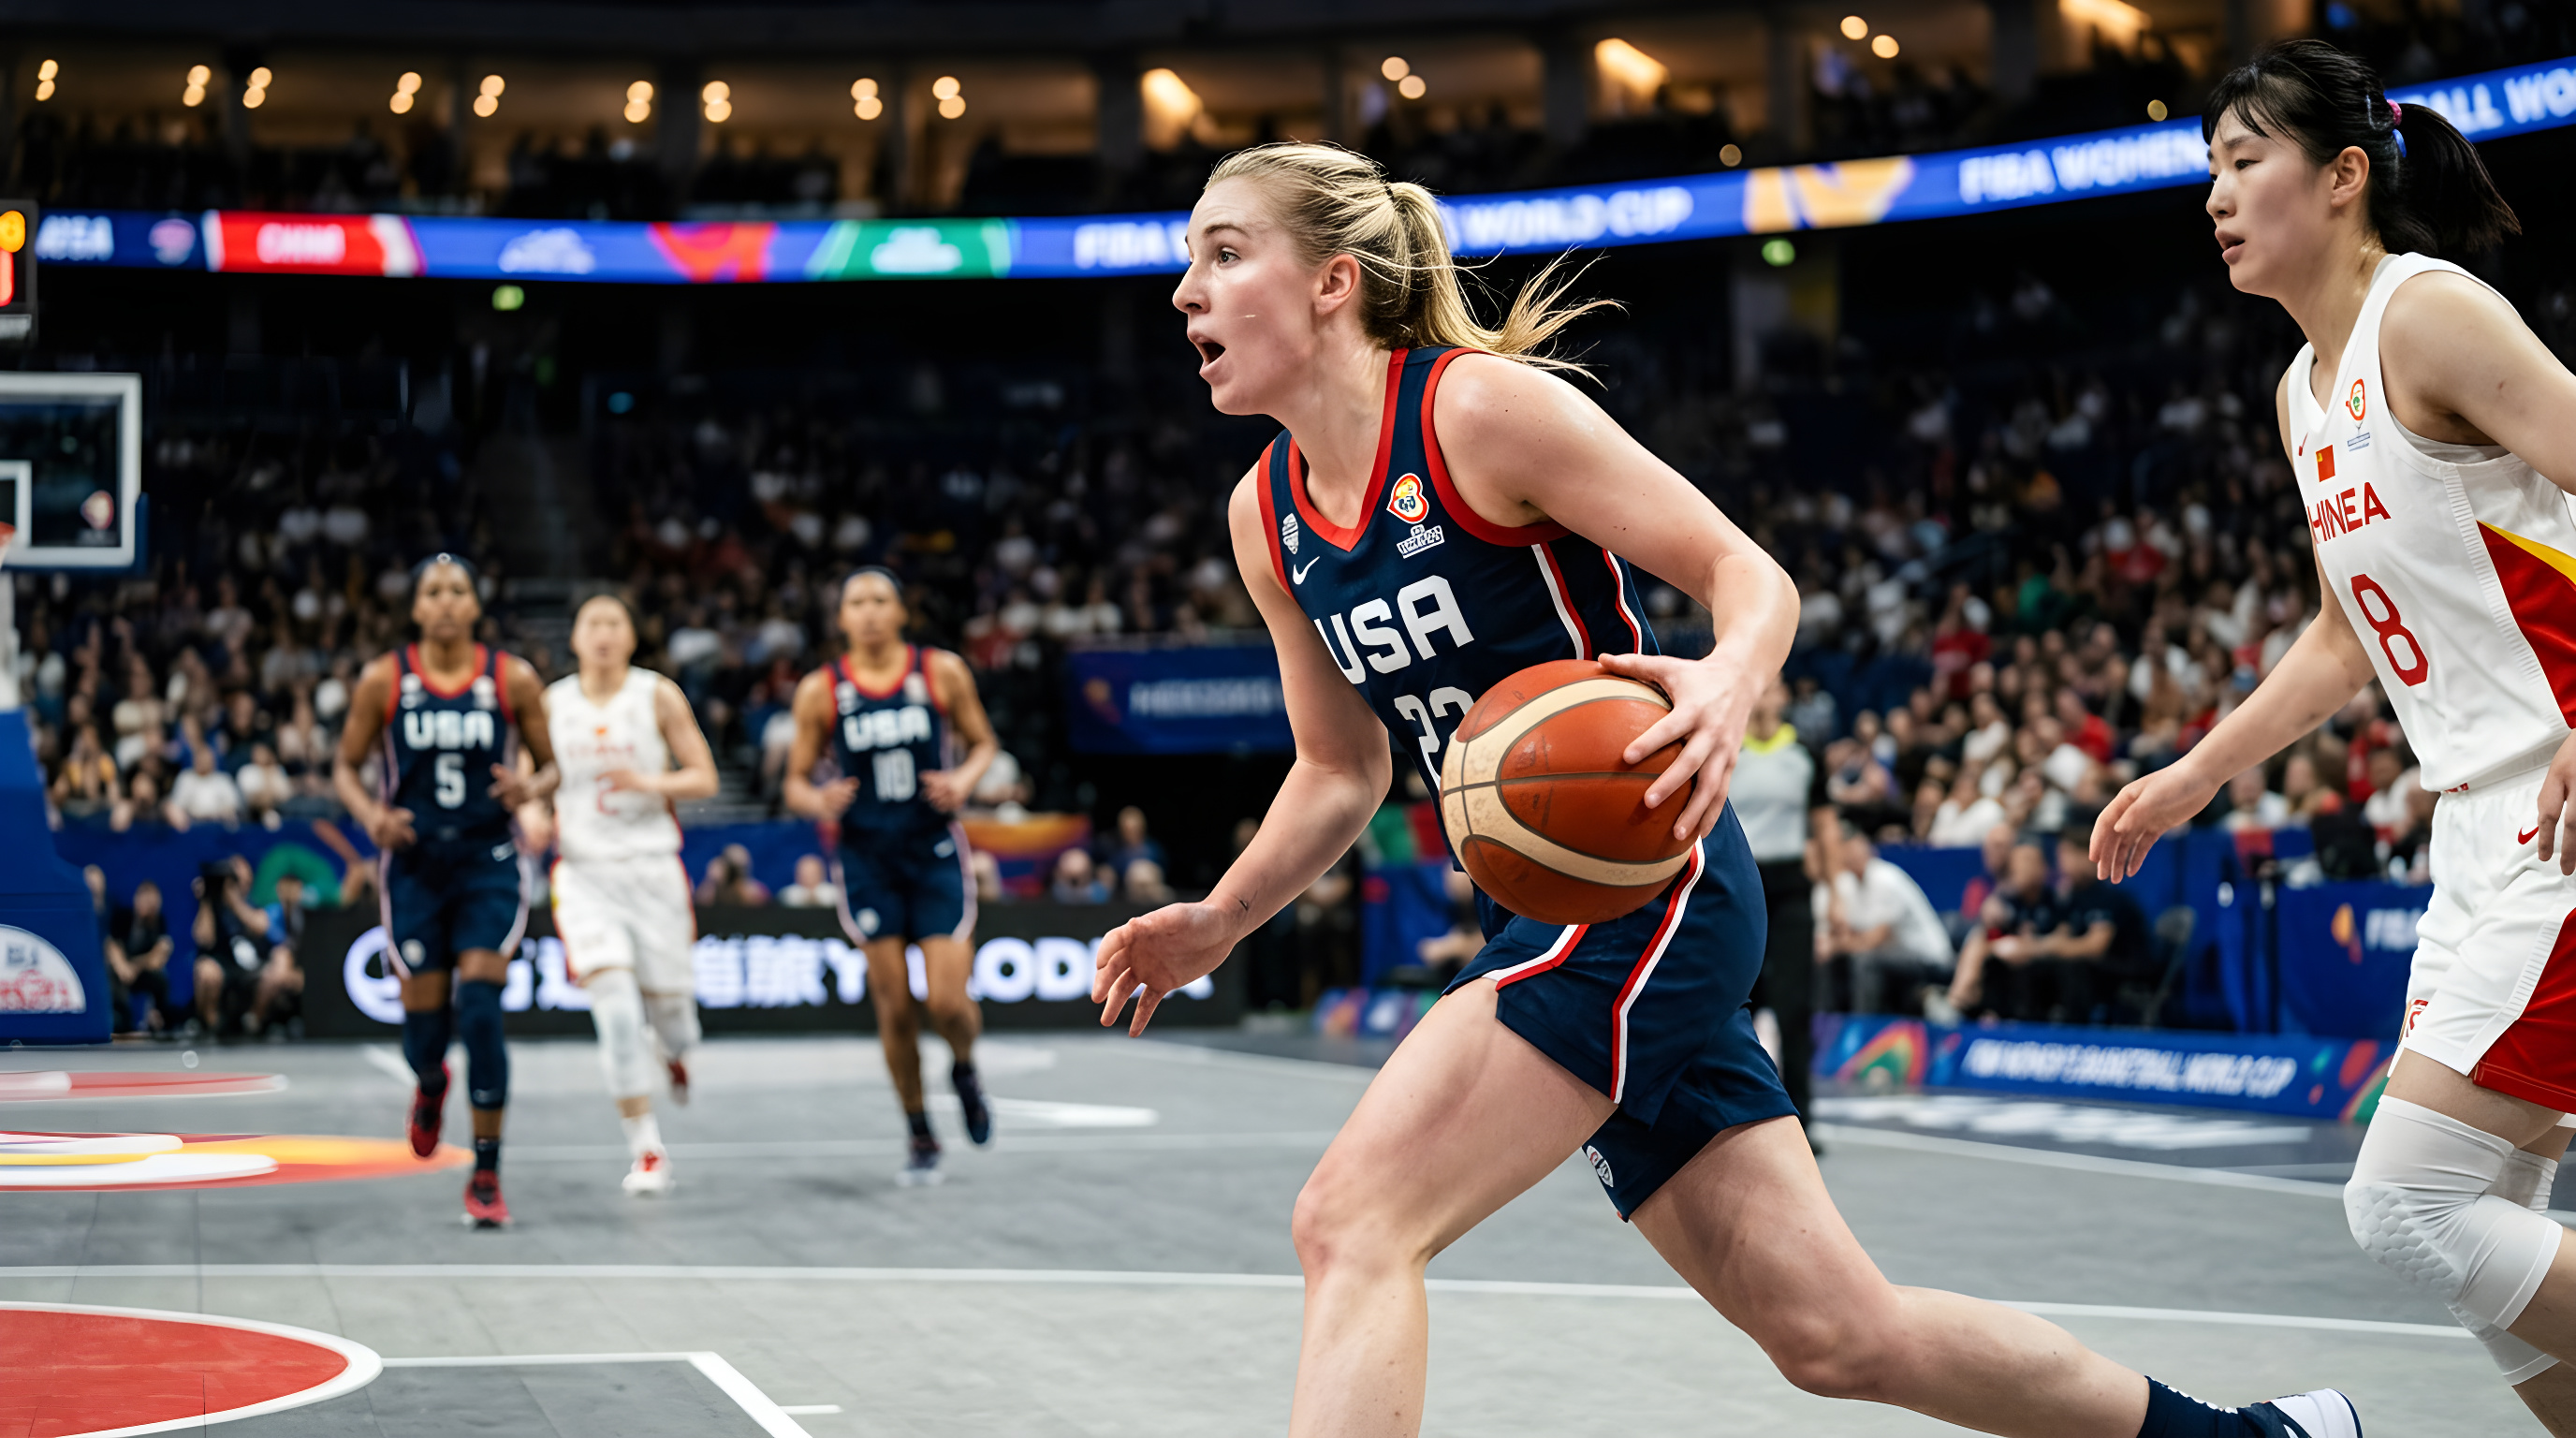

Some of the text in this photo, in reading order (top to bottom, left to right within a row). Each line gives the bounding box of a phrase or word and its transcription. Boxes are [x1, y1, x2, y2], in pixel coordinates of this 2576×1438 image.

[2399, 82, 2505, 134] ALL
[2504, 66, 2576, 124] WO
[1313, 574, 1475, 685] USA
[2350, 573, 2429, 687] 8
[403, 709, 495, 750] USA
[843, 706, 931, 753] USA
[434, 752, 466, 809] 5
